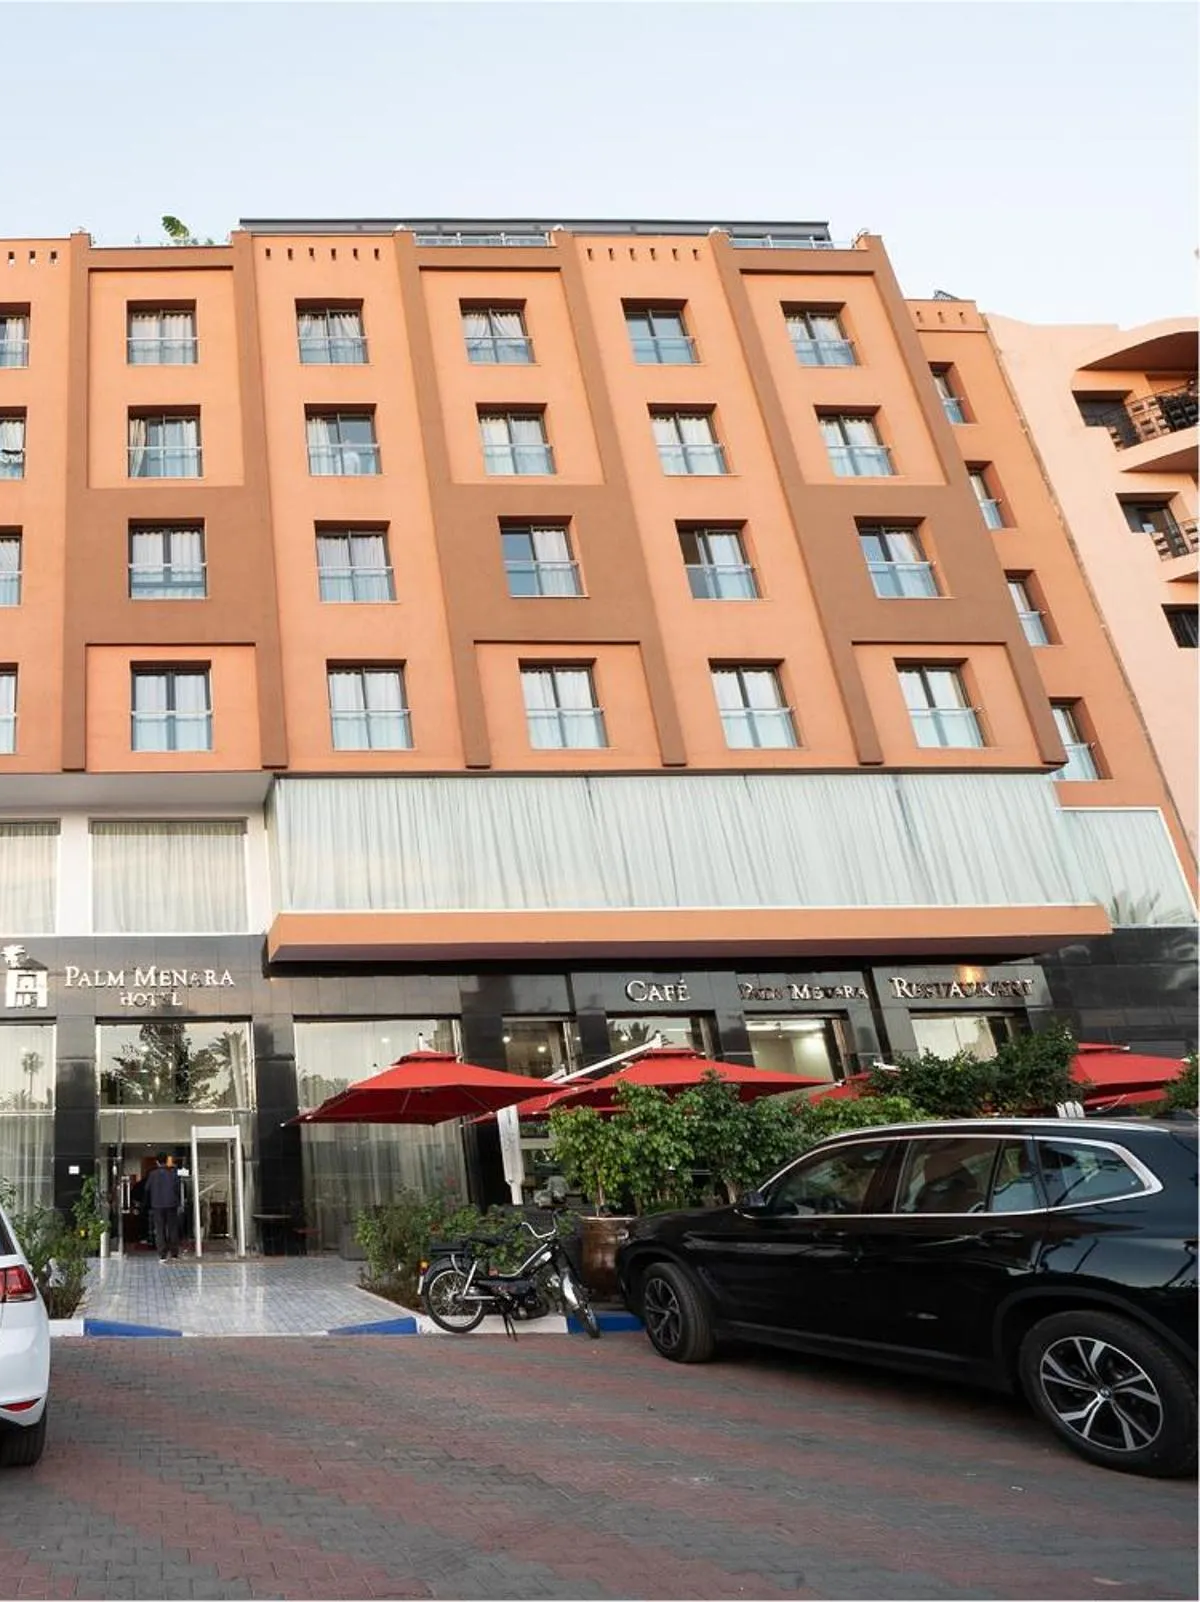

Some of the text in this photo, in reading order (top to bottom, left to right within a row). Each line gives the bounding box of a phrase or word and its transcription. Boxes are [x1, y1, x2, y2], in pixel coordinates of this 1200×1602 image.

[64, 965, 236, 987] PALM MENARA
[625, 978, 691, 1002] CAFÉ
